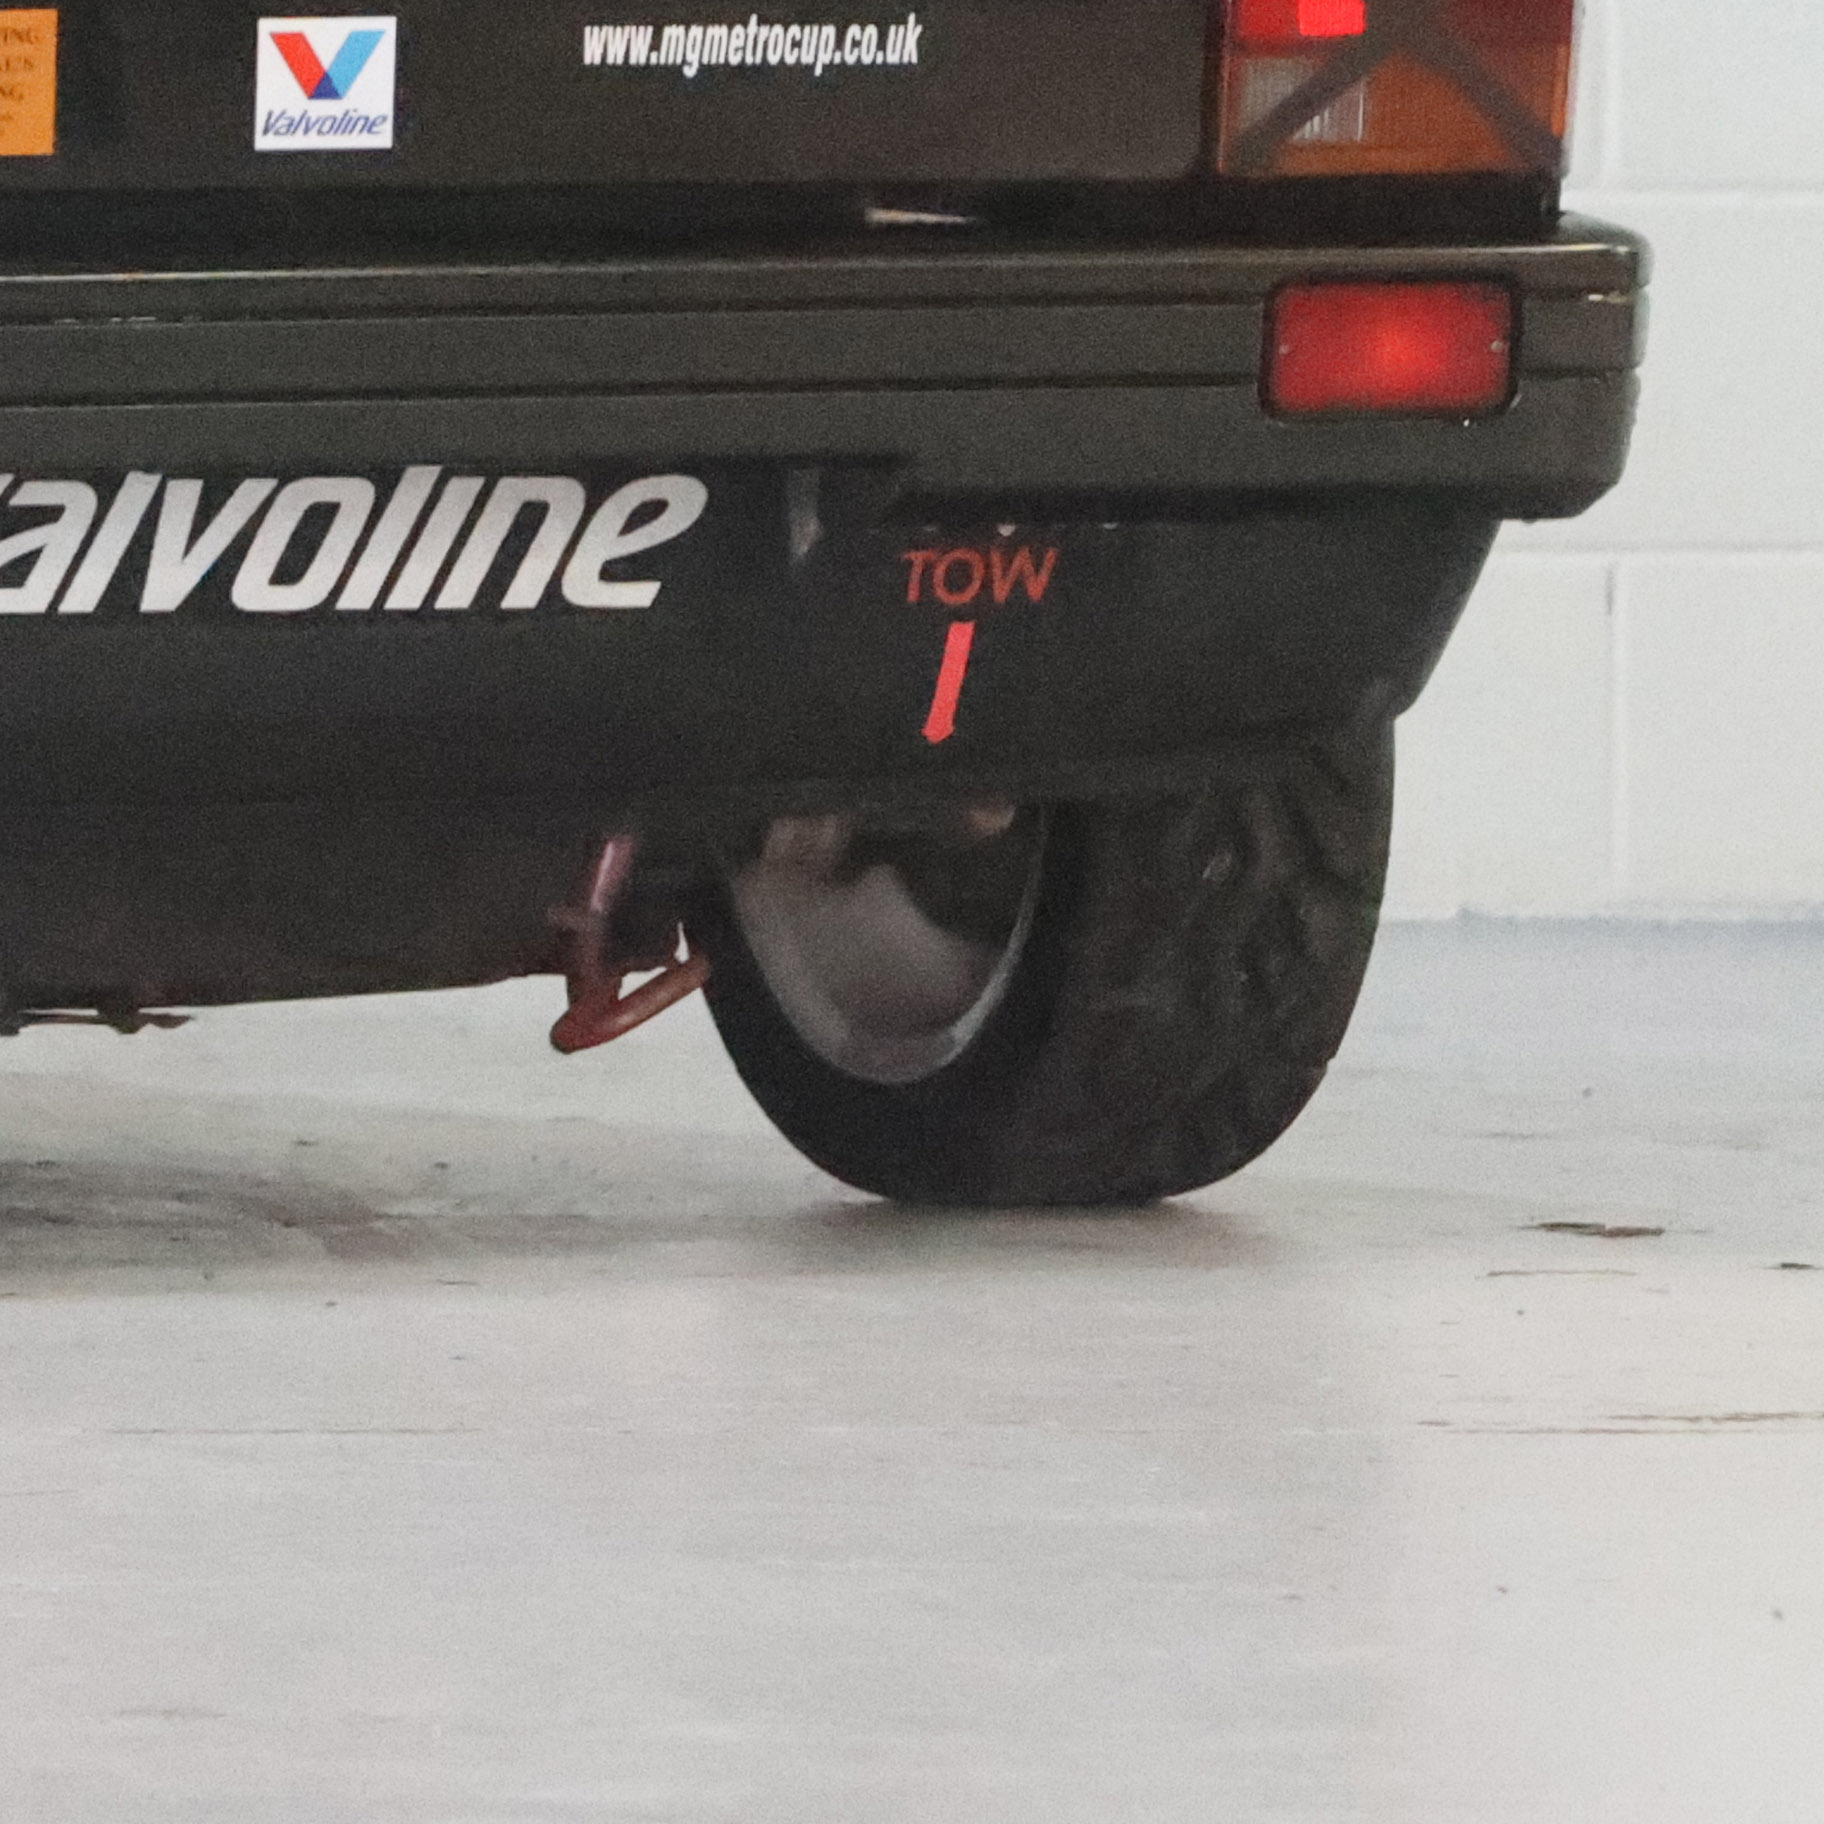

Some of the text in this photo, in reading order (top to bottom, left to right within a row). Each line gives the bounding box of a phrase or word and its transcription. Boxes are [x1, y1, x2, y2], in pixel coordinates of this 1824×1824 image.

[583, 12, 923, 78] www.mgmetrocup.co.uk
[261, 108, 389, 137] Valvoline
[898, 547, 1058, 605] TOW
